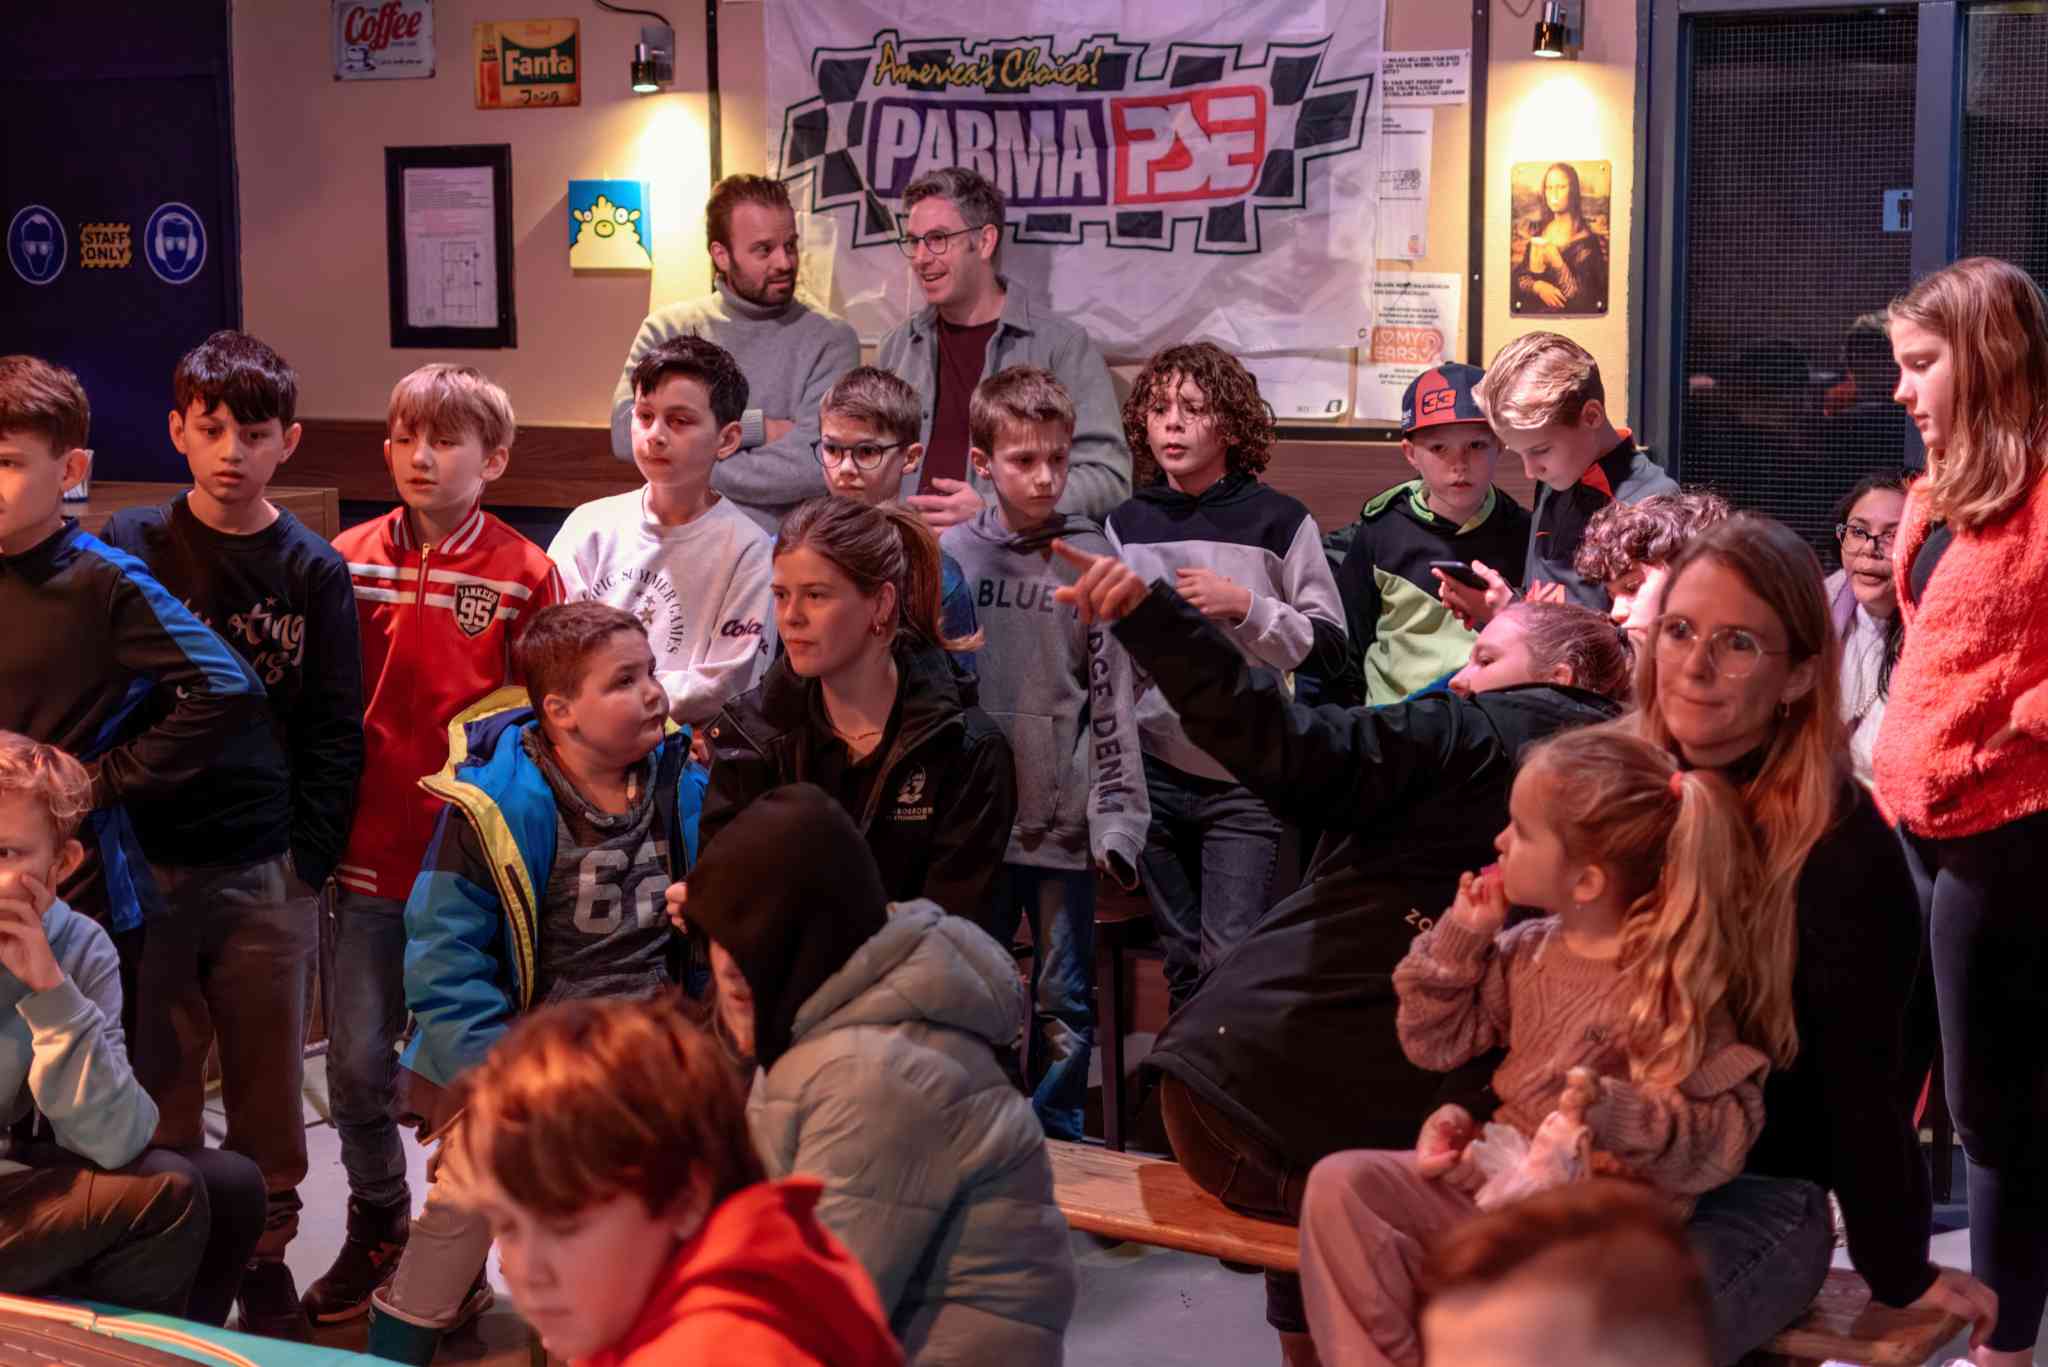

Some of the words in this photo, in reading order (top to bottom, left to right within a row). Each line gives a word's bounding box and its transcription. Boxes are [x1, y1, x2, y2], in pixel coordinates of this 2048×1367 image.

[344, 0, 422, 51] Coffee
[505, 47, 574, 82] Fanta
[873, 40, 996, 87] America's
[1001, 46, 1104, 88] Choice!
[875, 104, 1103, 199] PARMA
[1123, 95, 1257, 198] PSE
[84, 231, 129, 245] STAFF
[86, 247, 127, 260] ONLY
[1375, 346, 1419, 360] EARS
[1396, 330, 1425, 344] MY
[1423, 389, 1457, 416] 33
[458, 597, 492, 627] 95
[977, 579, 1055, 614] BLUE
[665, 603, 684, 655] GAMES
[1093, 716, 1132, 816] DENIM
